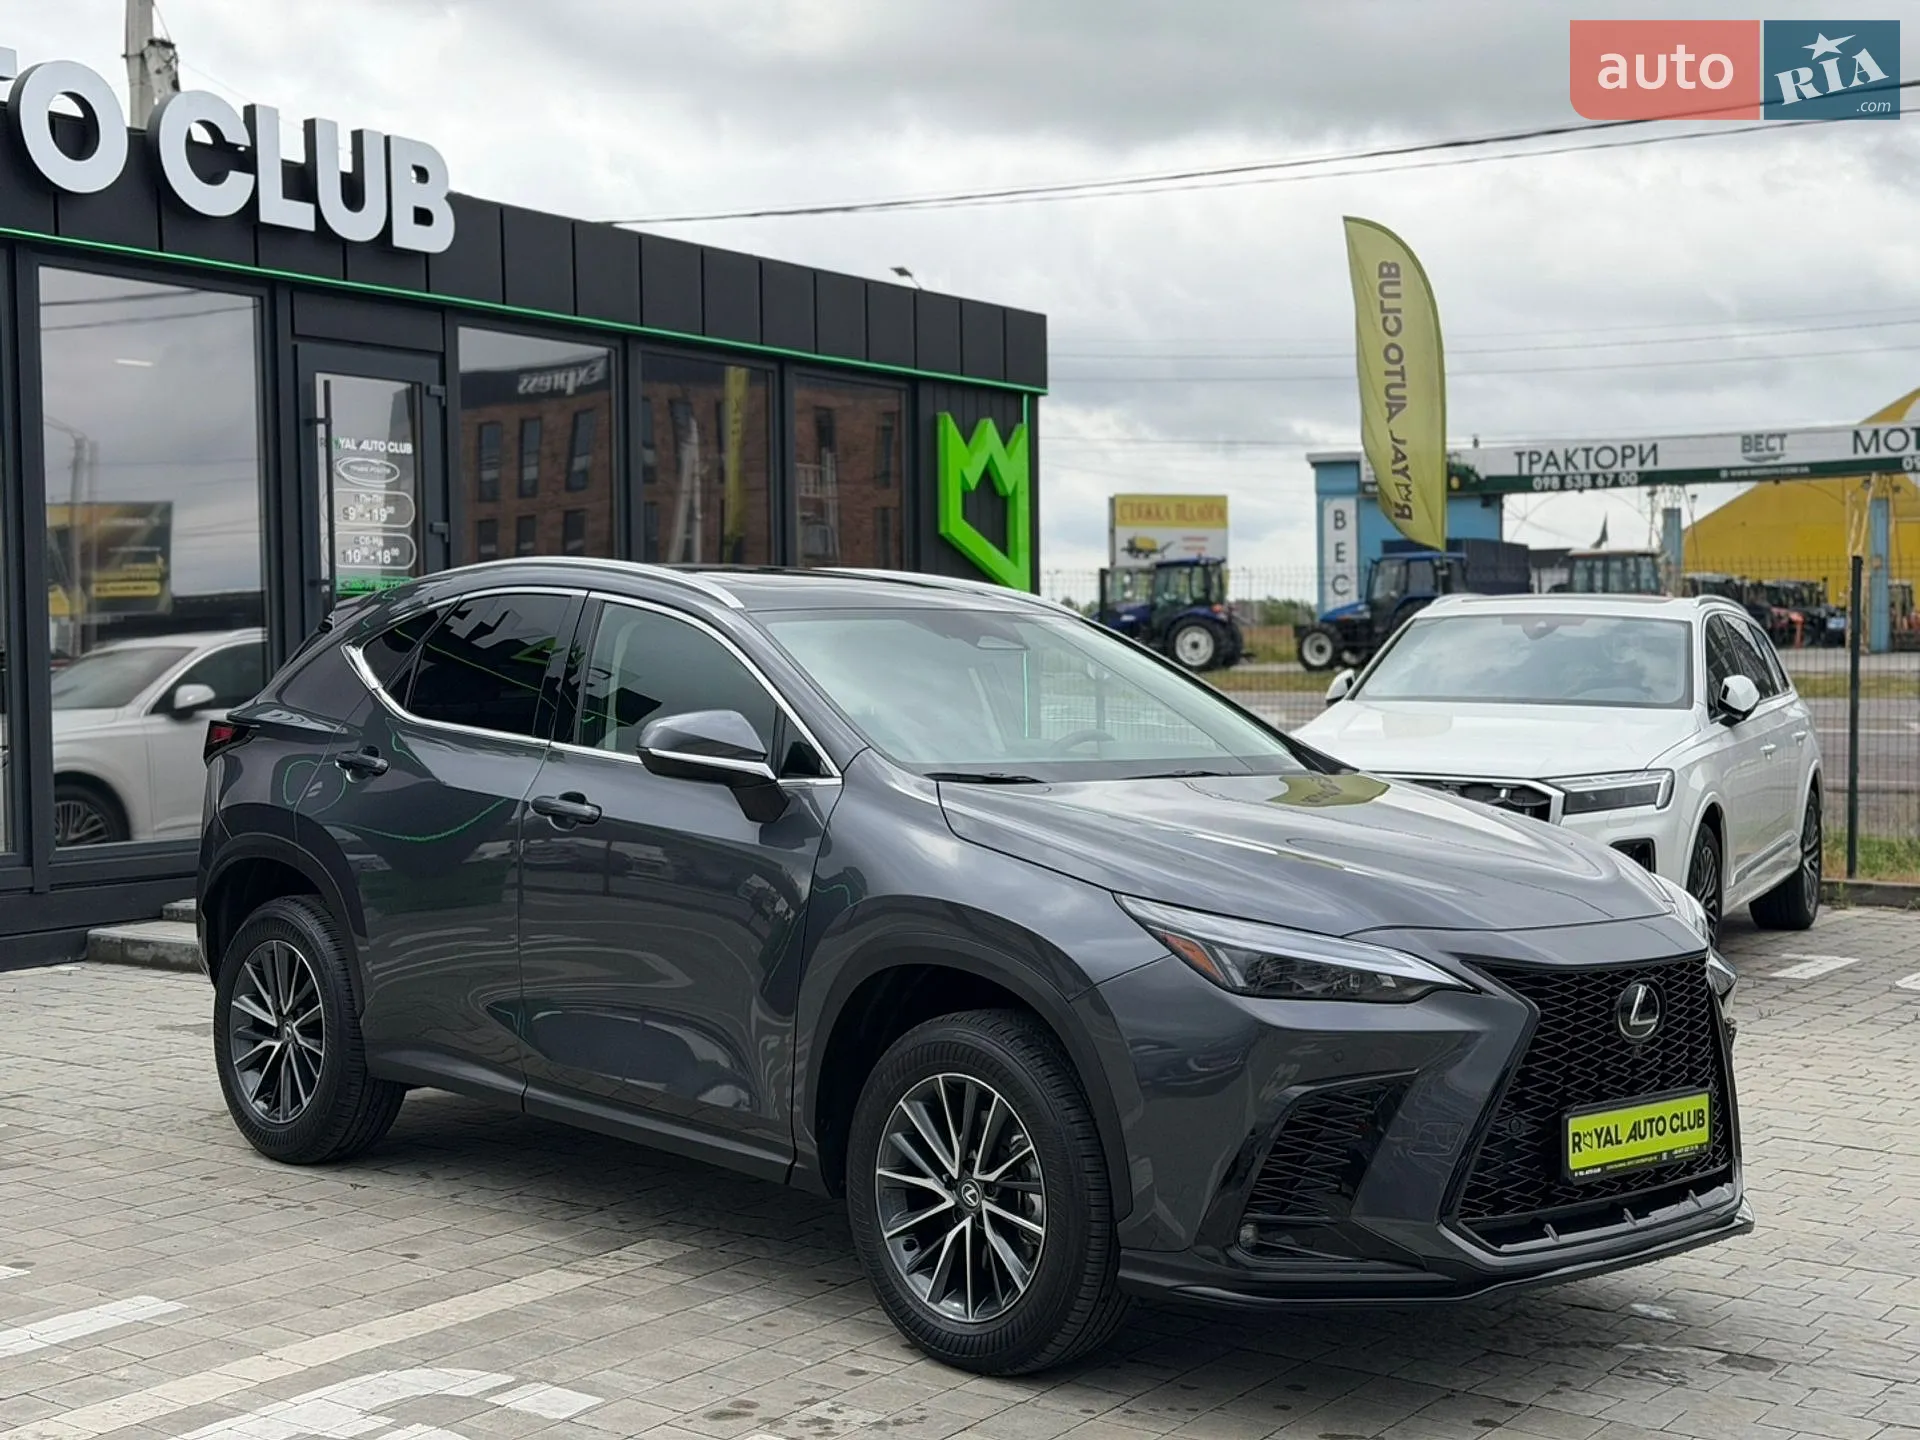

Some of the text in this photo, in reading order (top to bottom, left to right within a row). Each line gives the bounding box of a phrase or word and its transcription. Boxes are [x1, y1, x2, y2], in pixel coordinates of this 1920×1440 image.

[0, 46, 455, 254] O CLUB
[360, 439, 386, 452] AUTO
[388, 441, 413, 454] CLUB
[1741, 434, 1788, 453] ВЕСТ
[1514, 442, 1658, 476] ТРАКТОРИ
[1532, 475, 1561, 491] 098
[1564, 474, 1591, 489] 538
[1618, 471, 1639, 486] 00
[1625, 1115, 1667, 1144] AUTO
[1669, 1108, 1706, 1134] CLUB
